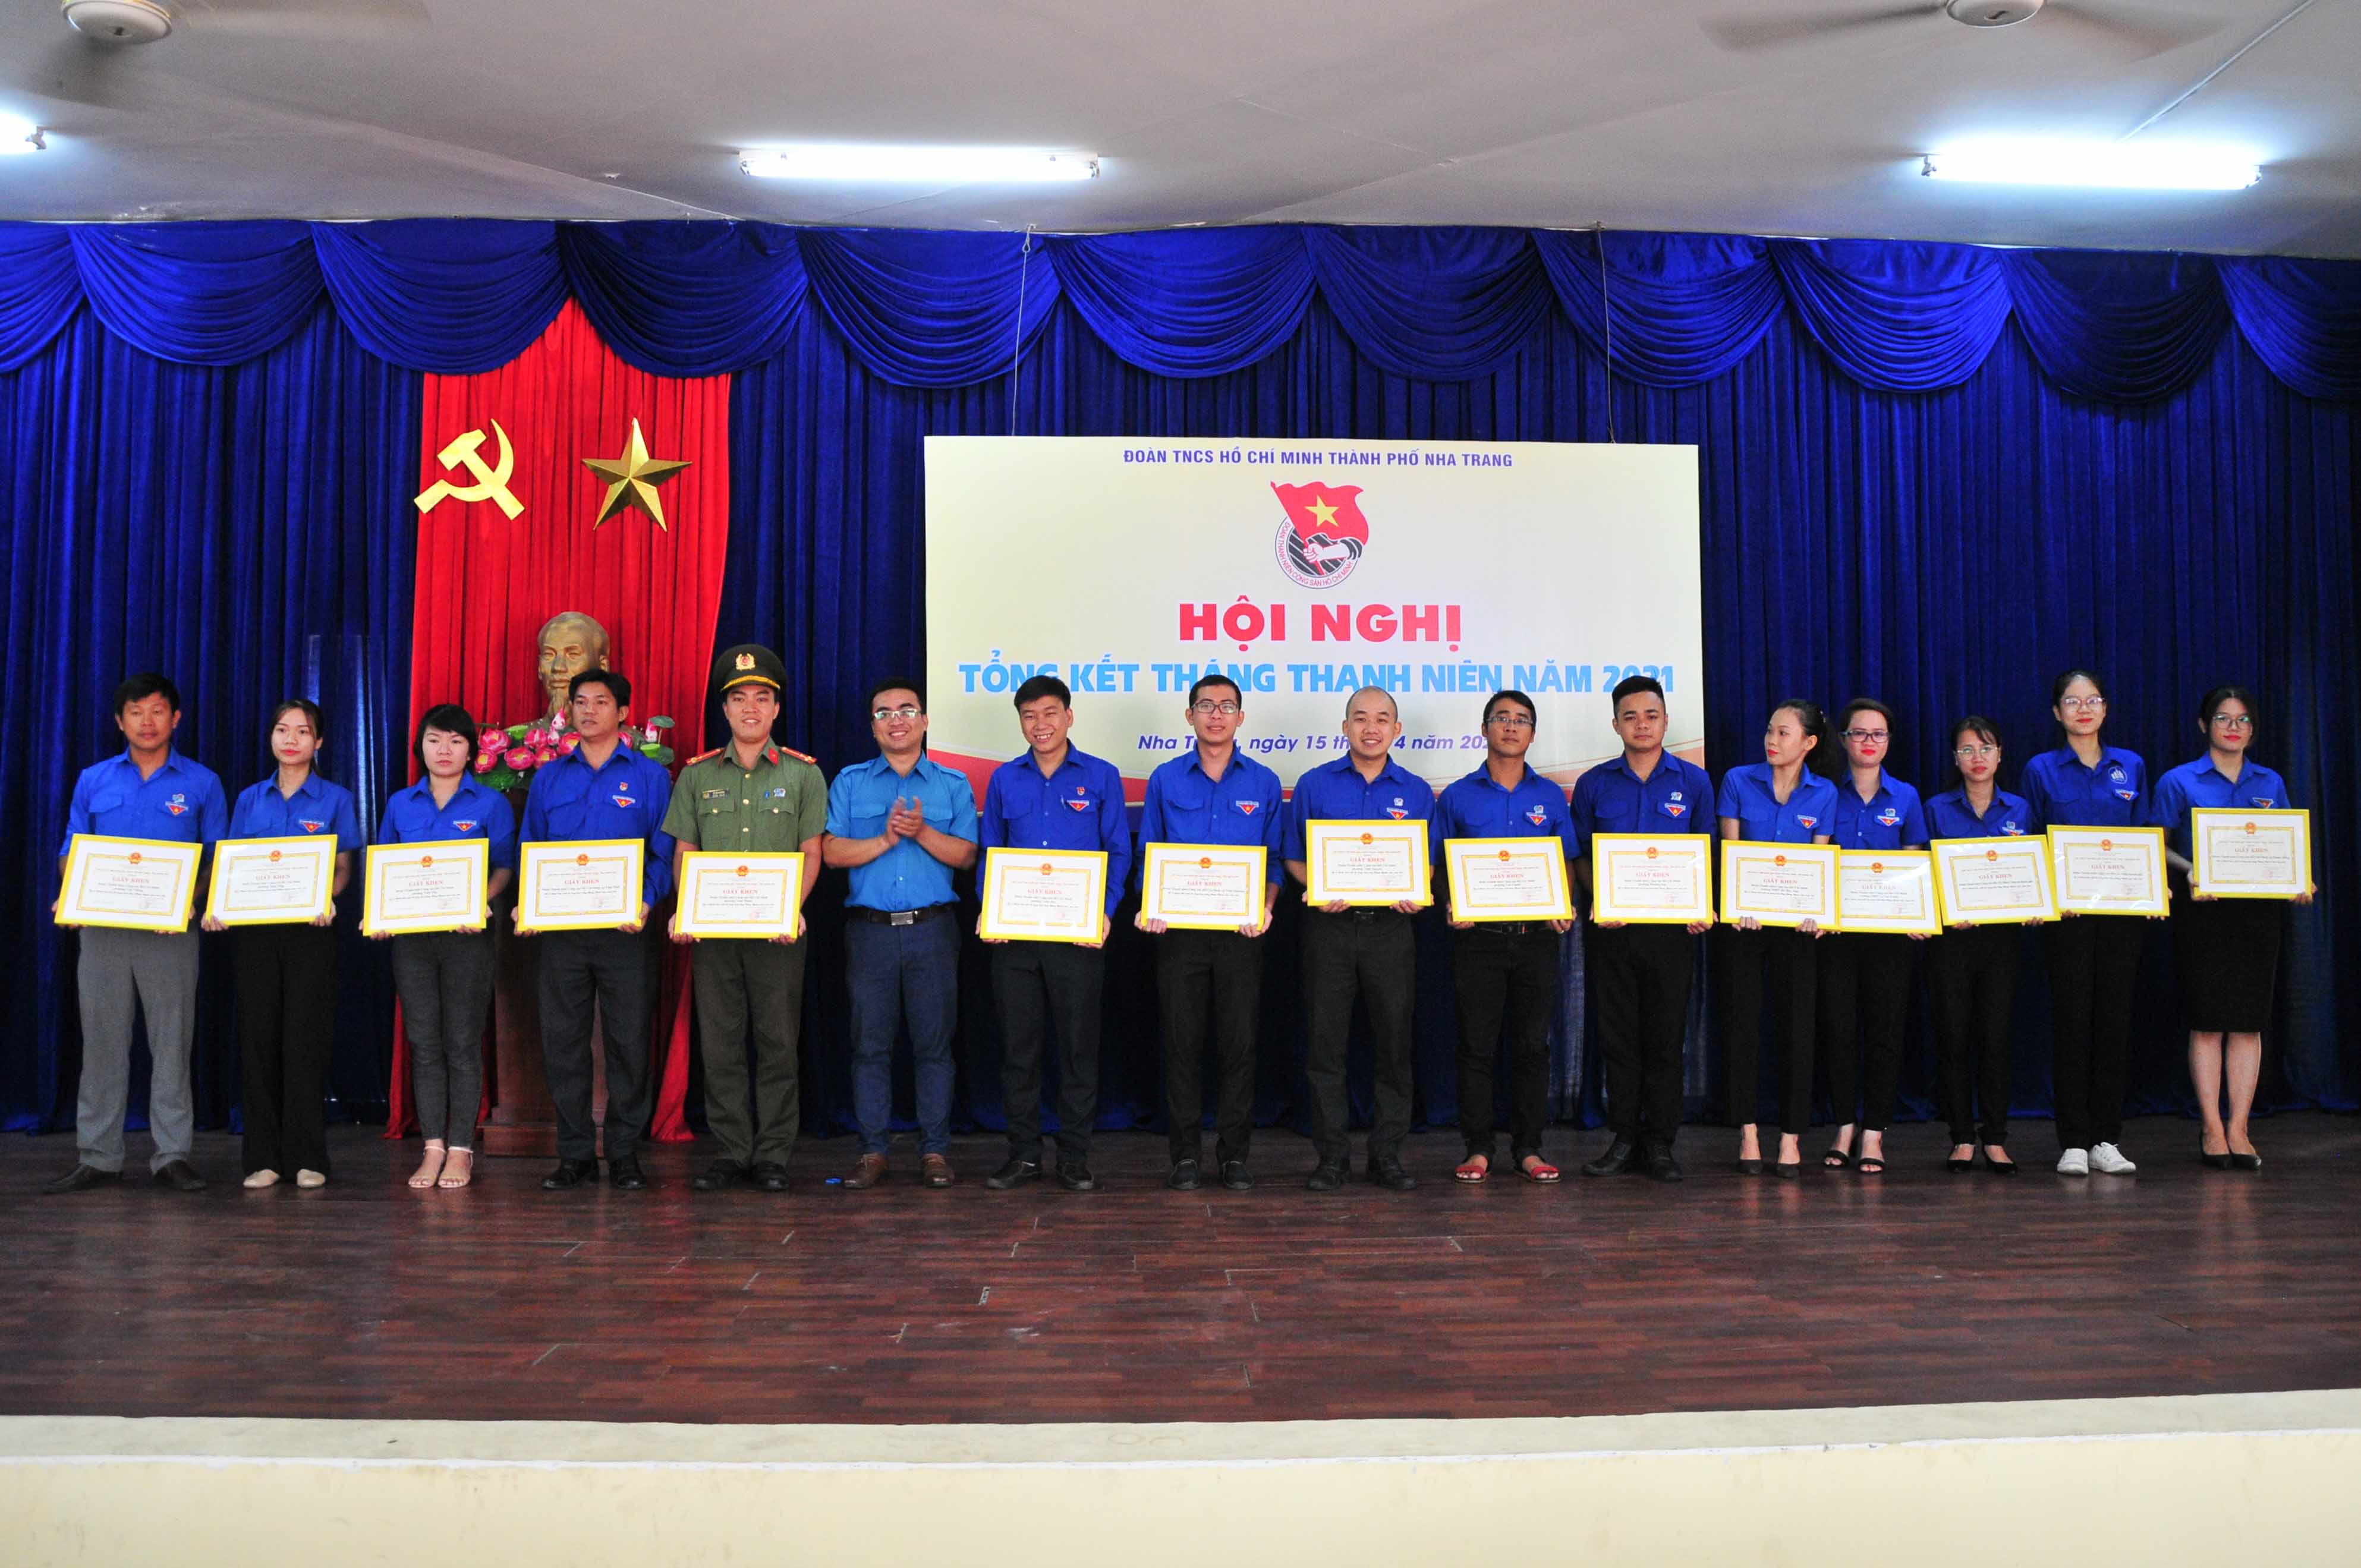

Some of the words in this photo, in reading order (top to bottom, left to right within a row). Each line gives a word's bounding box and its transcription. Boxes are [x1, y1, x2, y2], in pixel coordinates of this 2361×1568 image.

[1123, 447, 1166, 462] ĐOÀN
[1173, 450, 1213, 462] TNCS
[1220, 446, 1241, 463] HỒ
[1247, 448, 1274, 464] CHÍ
[1280, 452, 1323, 464] MINH
[1329, 449, 1380, 465] THÀNH
[1387, 448, 1419, 466] PHỐ
[1425, 454, 1456, 466] NHA
[1462, 454, 1512, 467] TRANG
[1180, 595, 1285, 651] HỘI
[1311, 604, 1461, 652] NGHỊ
[1071, 653, 1139, 692] KẾT
[1287, 665, 1411, 692] THANH
[1422, 660, 1502, 692] NIÊN
[1513, 660, 1592, 692] NĂM
[1138, 735, 1178, 750] Nha
[1249, 734, 1299, 754] ngày
[1306, 735, 1327, 750] 15
[1411, 735, 1454, 750] năm
[1459, 735, 1489, 750] 20
